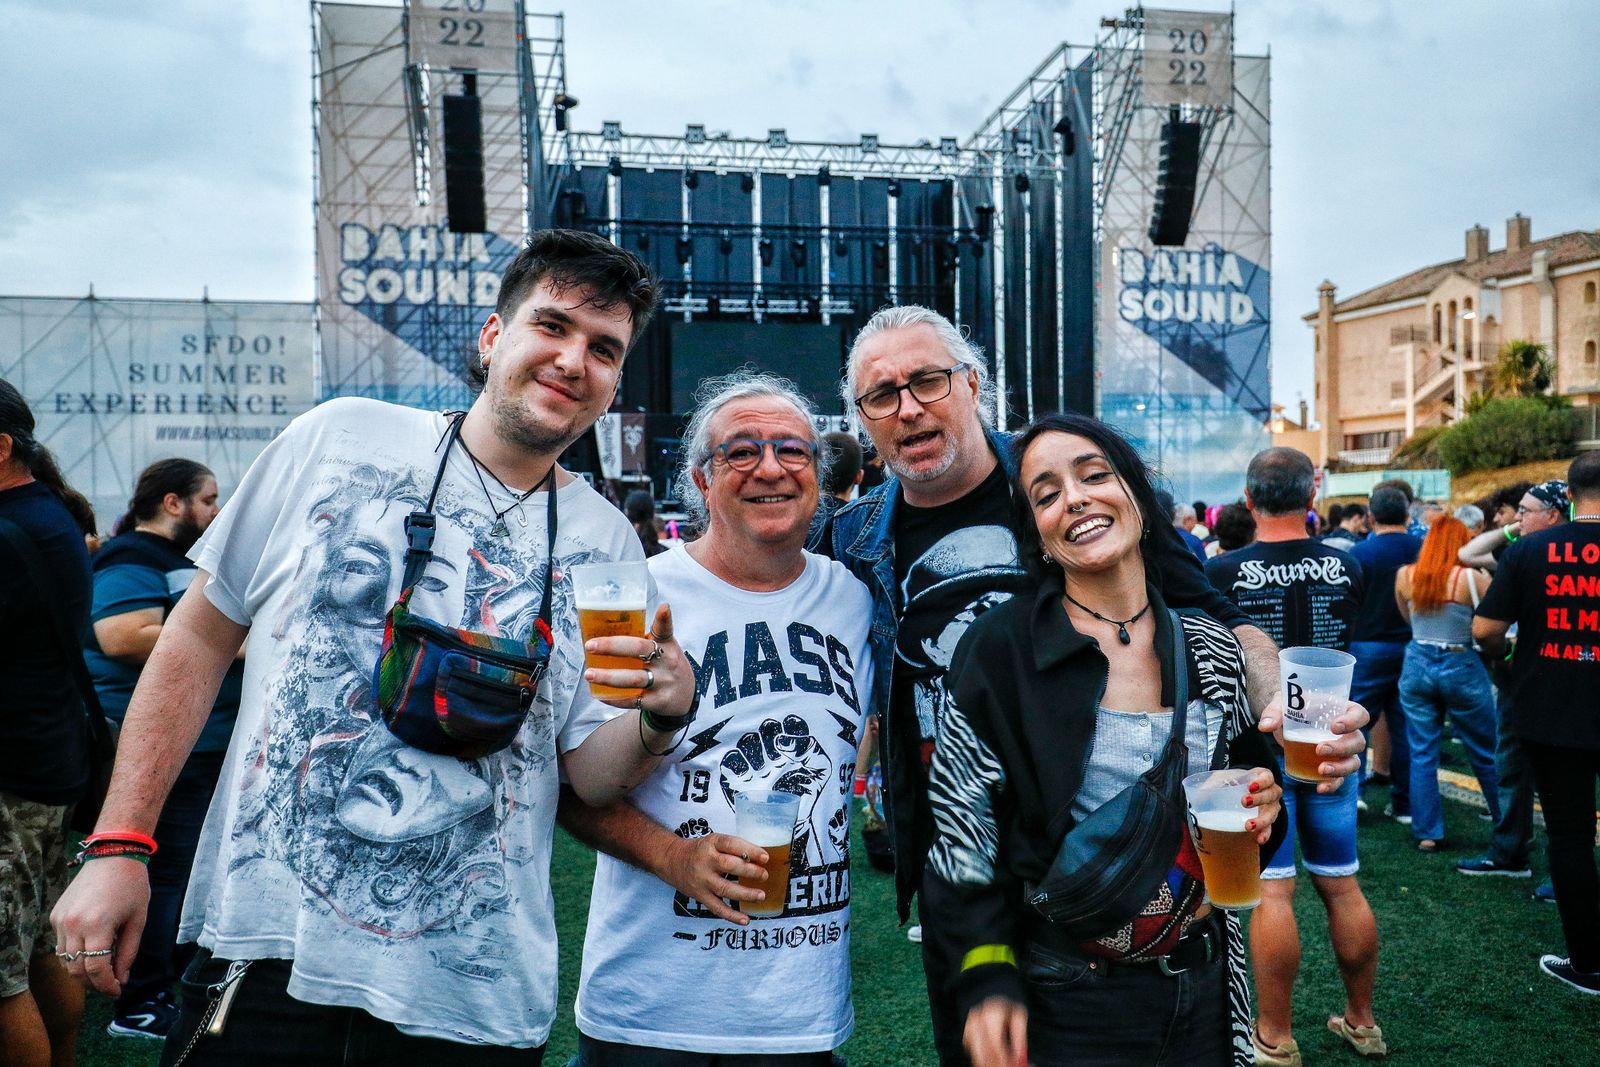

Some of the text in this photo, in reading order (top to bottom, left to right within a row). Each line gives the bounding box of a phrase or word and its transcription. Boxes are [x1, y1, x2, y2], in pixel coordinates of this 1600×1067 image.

[439, 16, 485, 48] 22
[1169, 29, 1207, 54] 20
[1169, 59, 1207, 86] 22
[338, 266, 502, 306] SOUND
[1119, 288, 1255, 325] SOUND
[181, 334, 287, 355] SFDO!
[128, 363, 288, 385] SUMMER
[54, 393, 288, 415] EXPERIENCE
[1547, 607, 1600, 631] EL M
[684, 621, 862, 717] MASS
[679, 770, 711, 804] 19
[700, 921, 841, 951] FURIOUS
